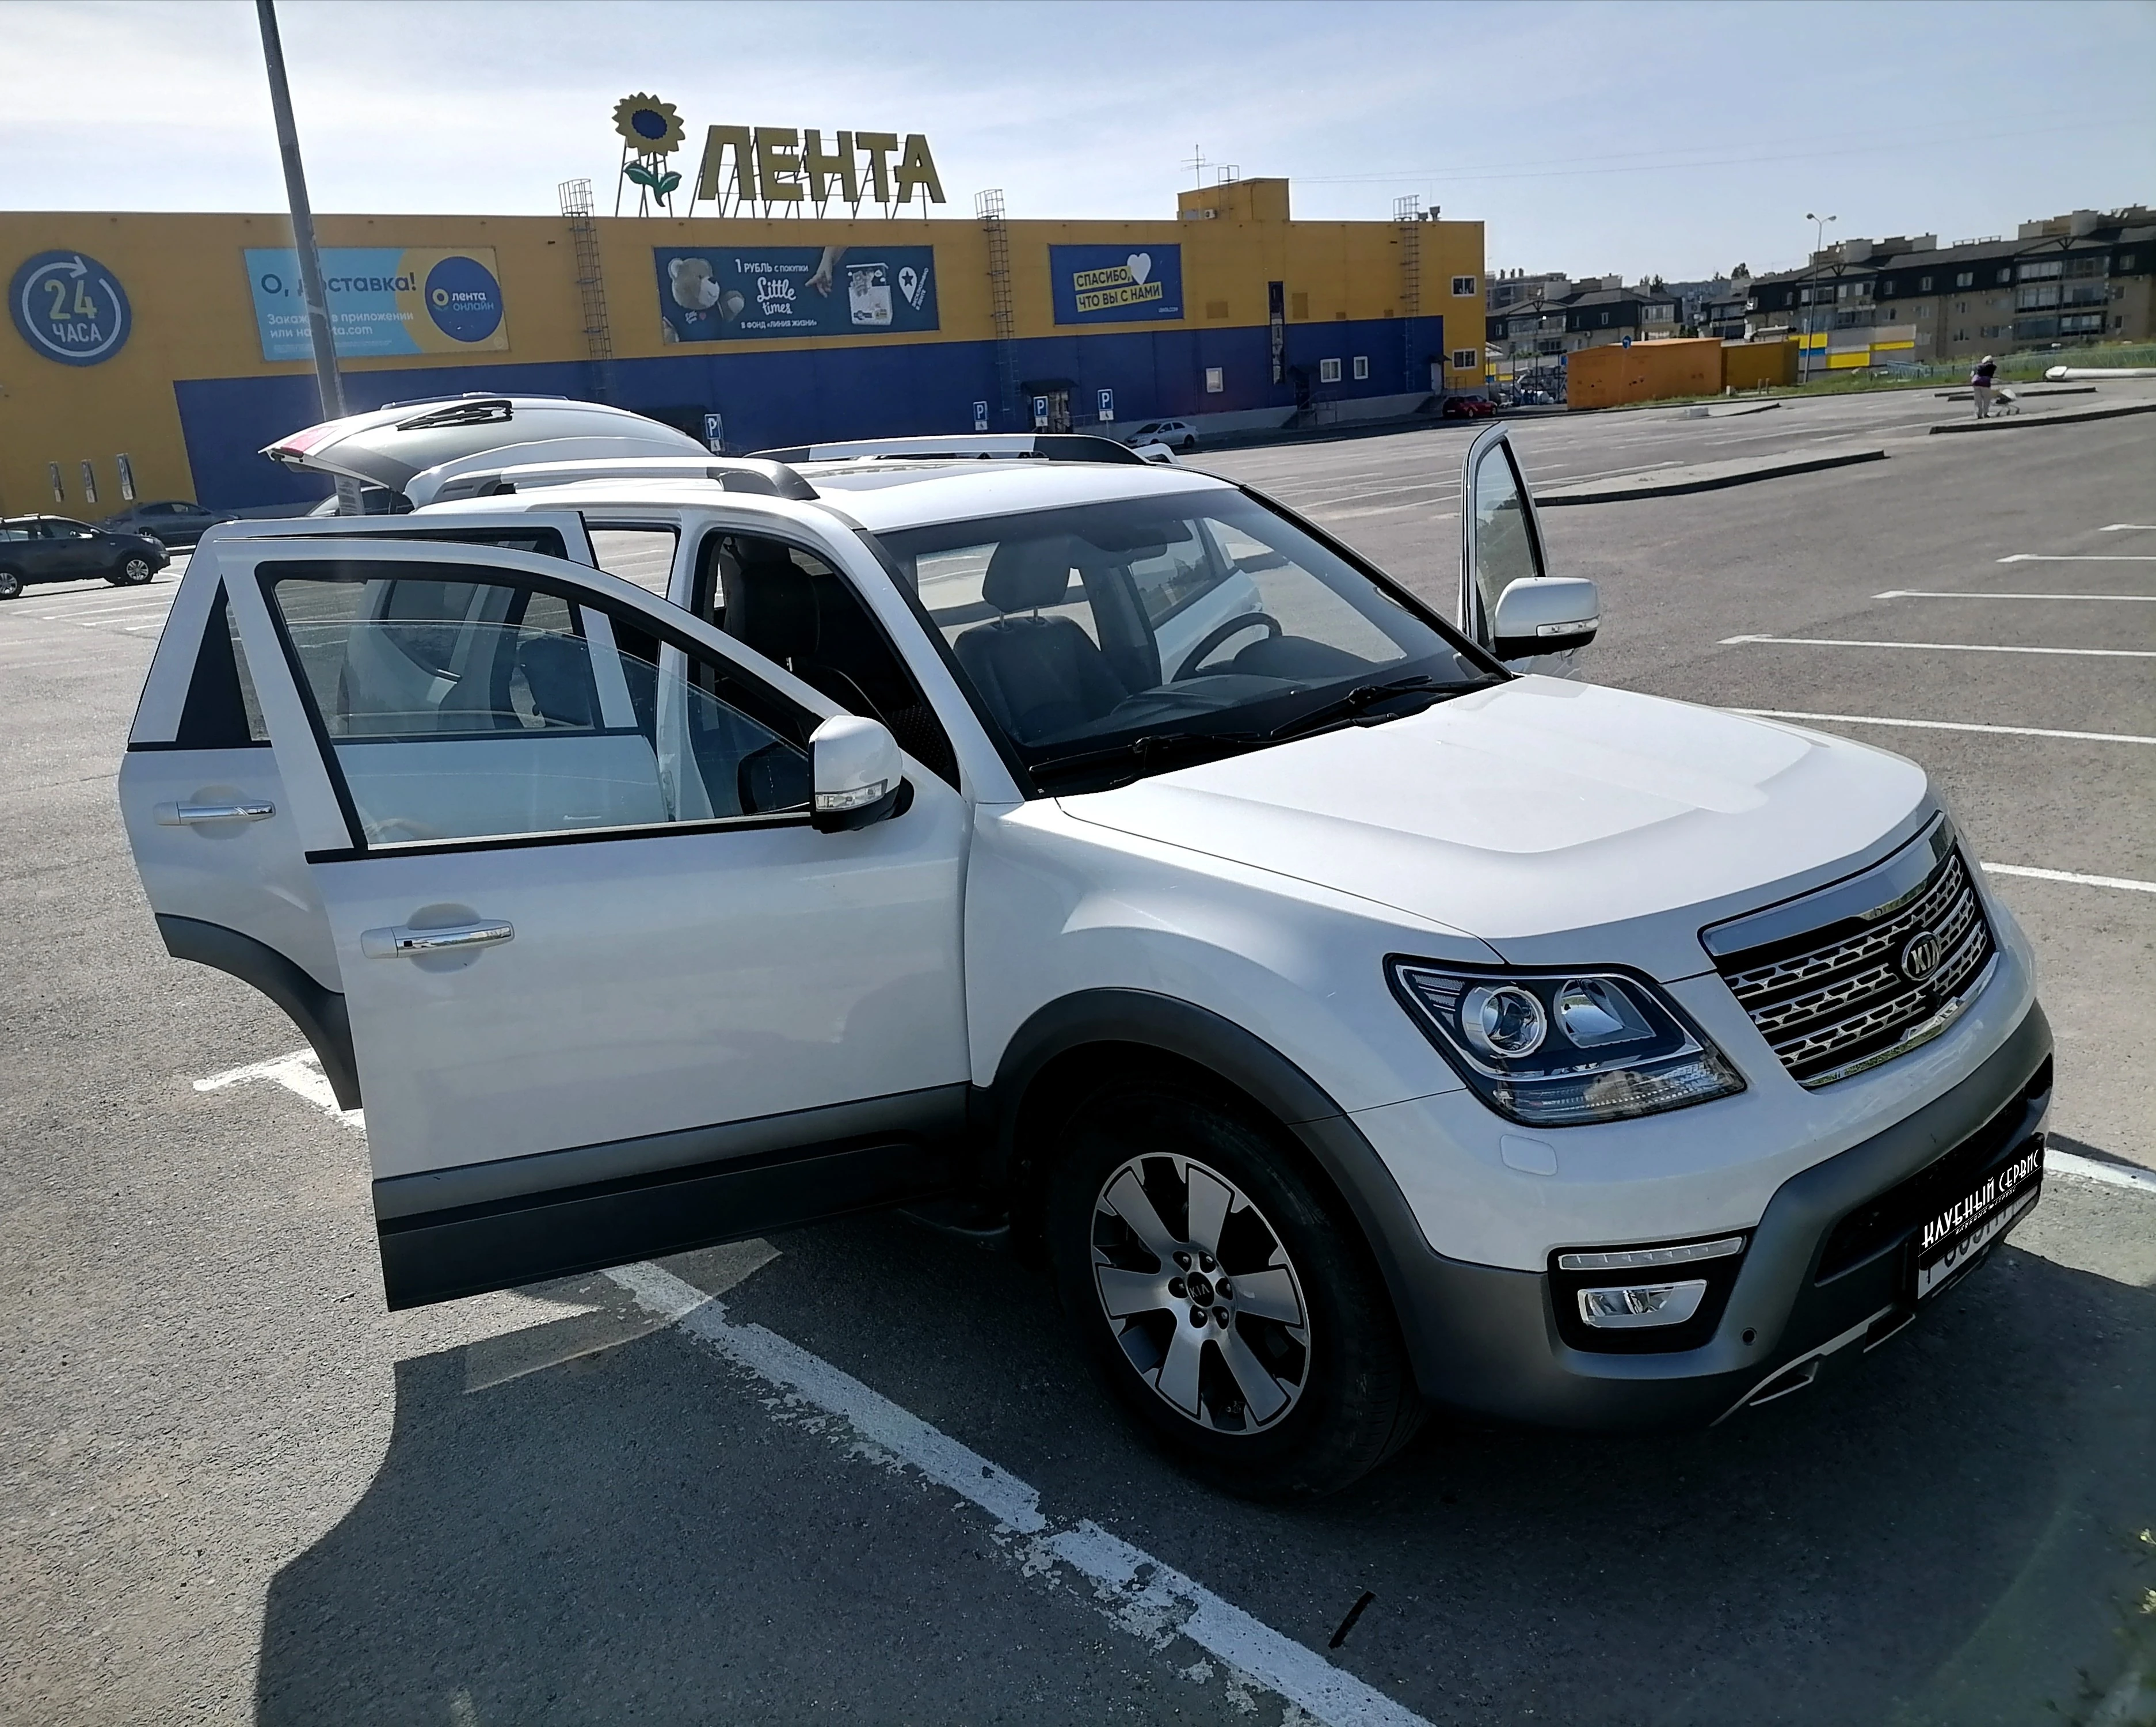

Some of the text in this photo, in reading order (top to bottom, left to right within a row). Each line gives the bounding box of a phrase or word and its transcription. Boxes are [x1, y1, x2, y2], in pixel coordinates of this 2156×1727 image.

[698, 125, 946, 203] ЛЕНТА
[735, 258, 741, 273] 1
[744, 263, 772, 273] РУБЛЬ
[297, 272, 417, 296] ставка!
[1076, 268, 1130, 287] СПАСИБО,
[452, 292, 486, 301] лента
[757, 276, 797, 302] Little
[1079, 284, 1160, 309] ЧТО ВЫ С НАМИ
[44, 279, 97, 319] 24
[453, 300, 494, 311] онлайн
[763, 302, 793, 315] times
[341, 312, 414, 324] приложении
[52, 322, 102, 343] ЧАСА
[270, 329, 293, 338] или
[1037, 400, 1045, 414] P
[1102, 393, 1110, 408] P
[977, 405, 984, 419] P
[707, 417, 717, 436] P
[1911, 939, 1940, 974] KIA
[1189, 1284, 1210, 1298] KIA
